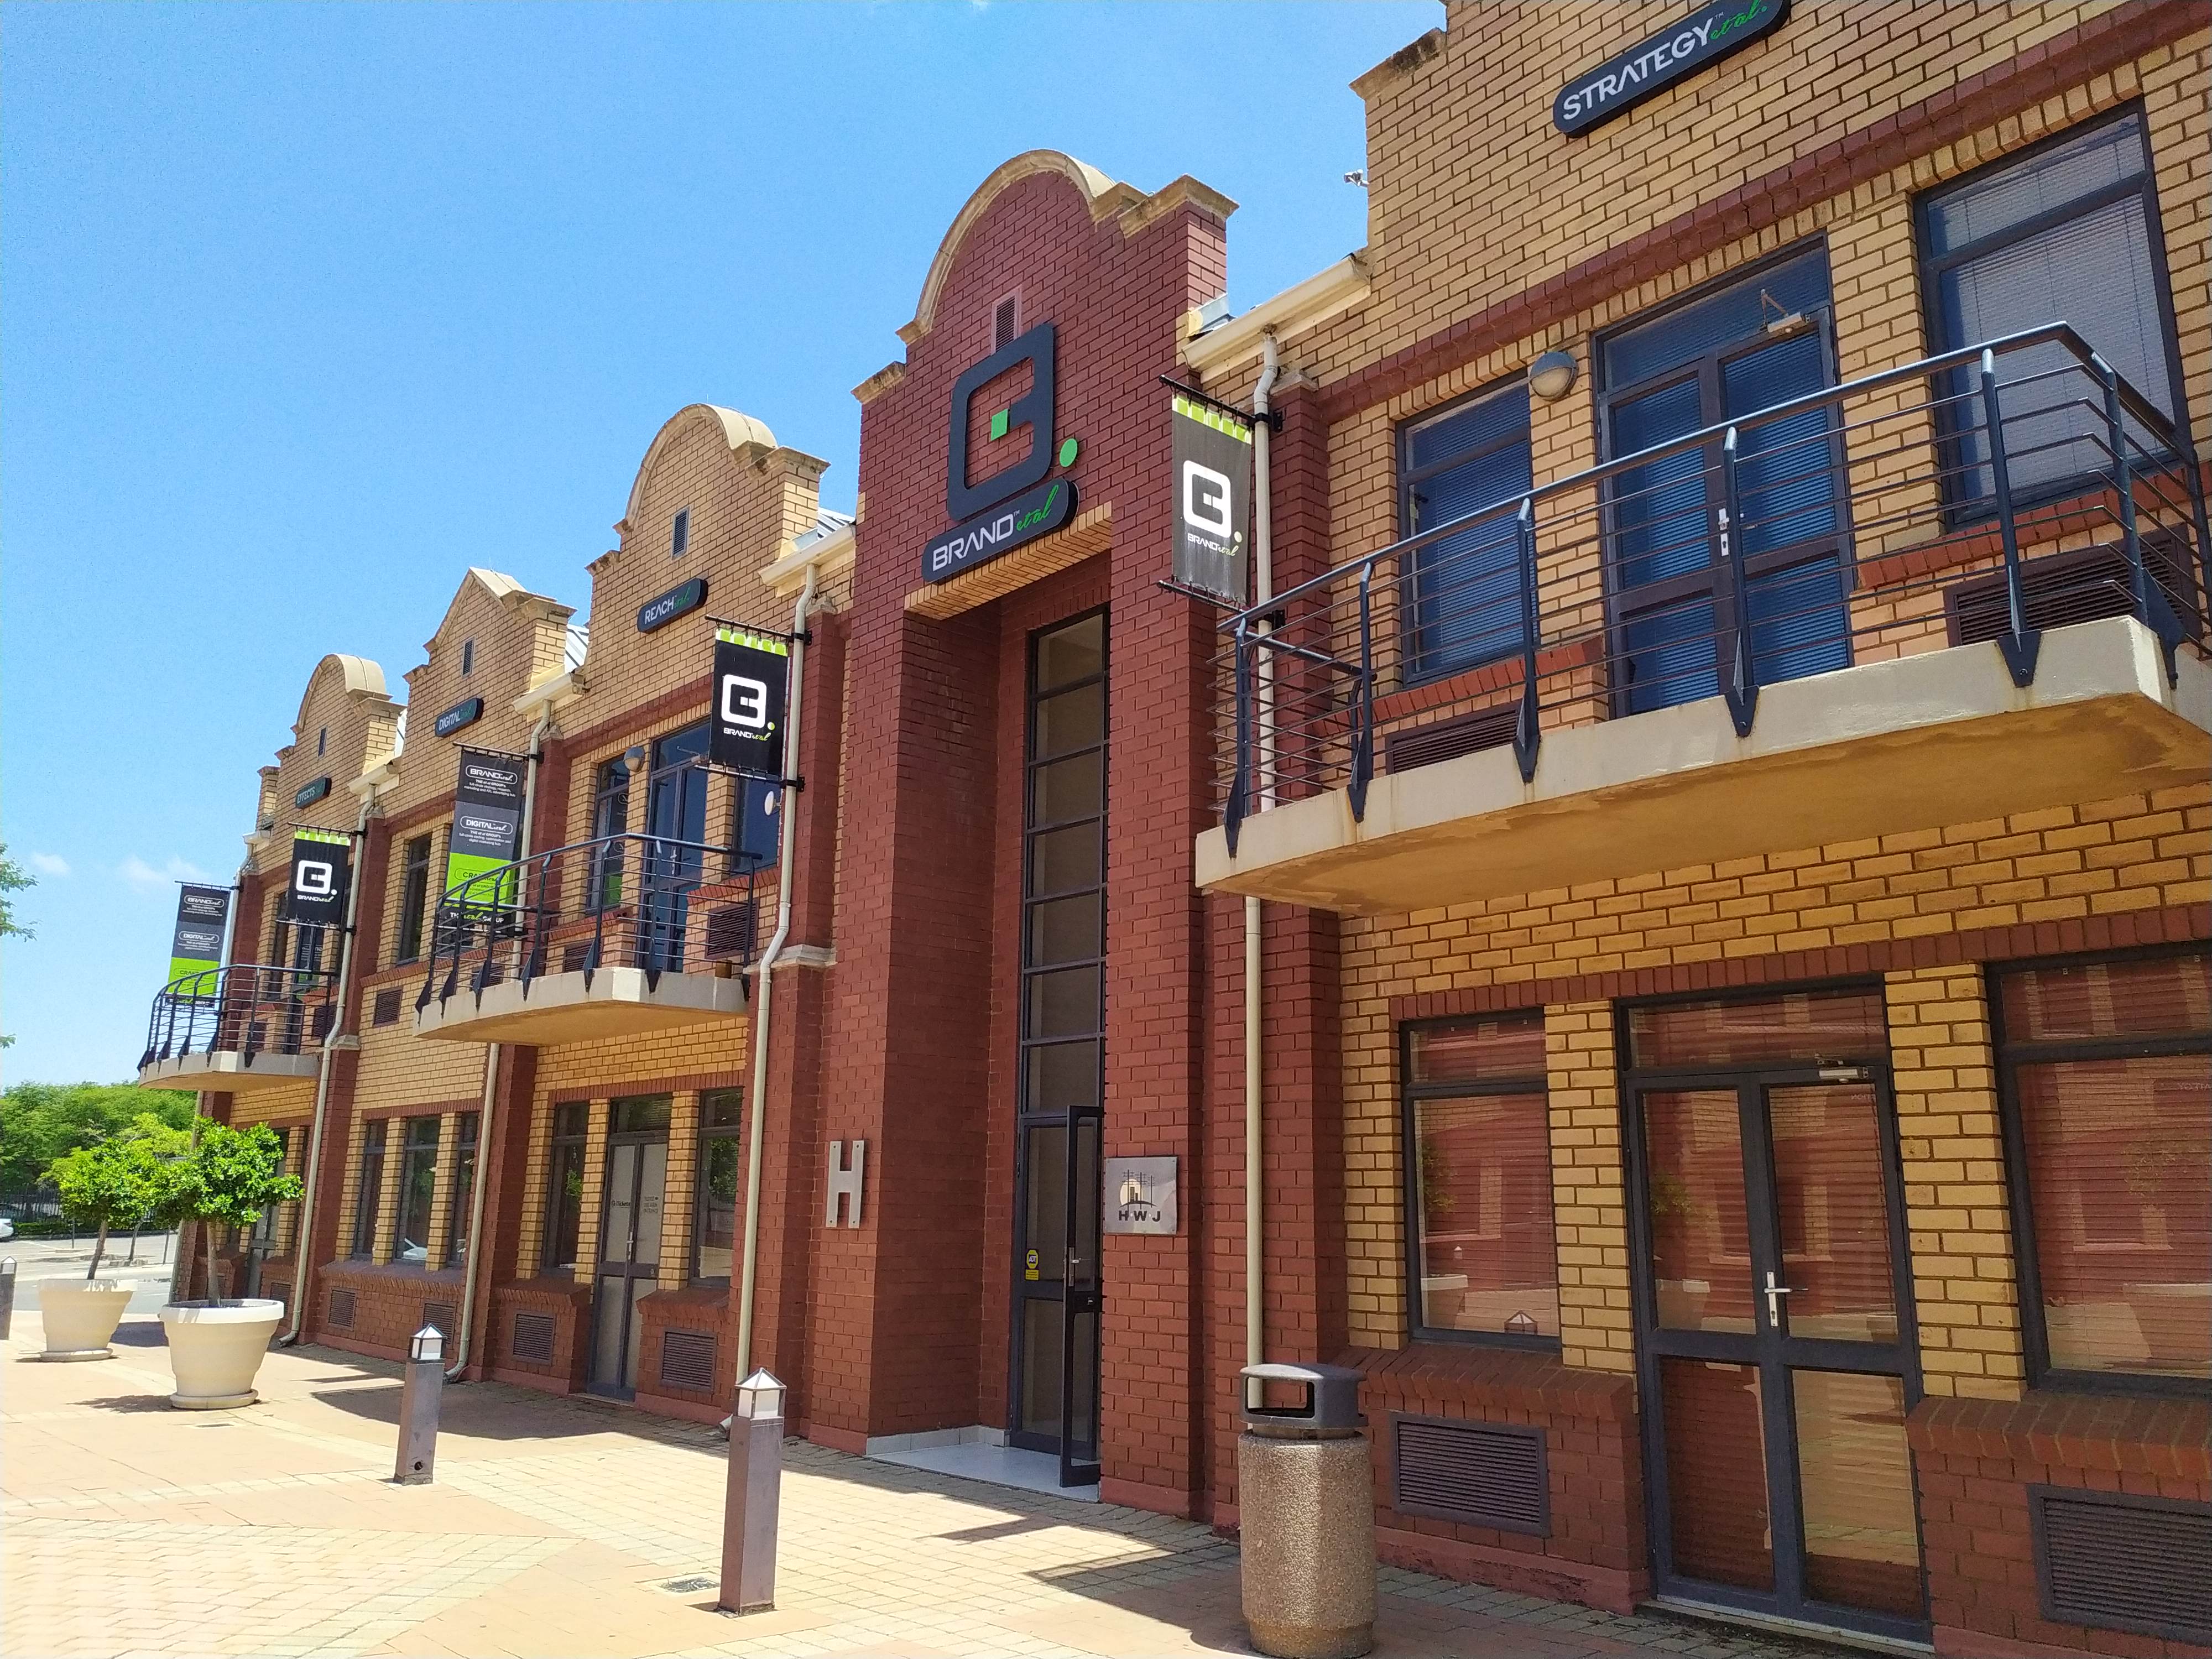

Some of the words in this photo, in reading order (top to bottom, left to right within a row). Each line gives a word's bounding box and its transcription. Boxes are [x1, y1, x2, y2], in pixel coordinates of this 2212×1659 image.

[644, 596, 675, 624] REACH
[439, 711, 461, 731] DIGITAL
[470, 768, 501, 779] BRAND
[466, 819, 494, 830] DIGITAL
[826, 1140, 865, 1228] H
